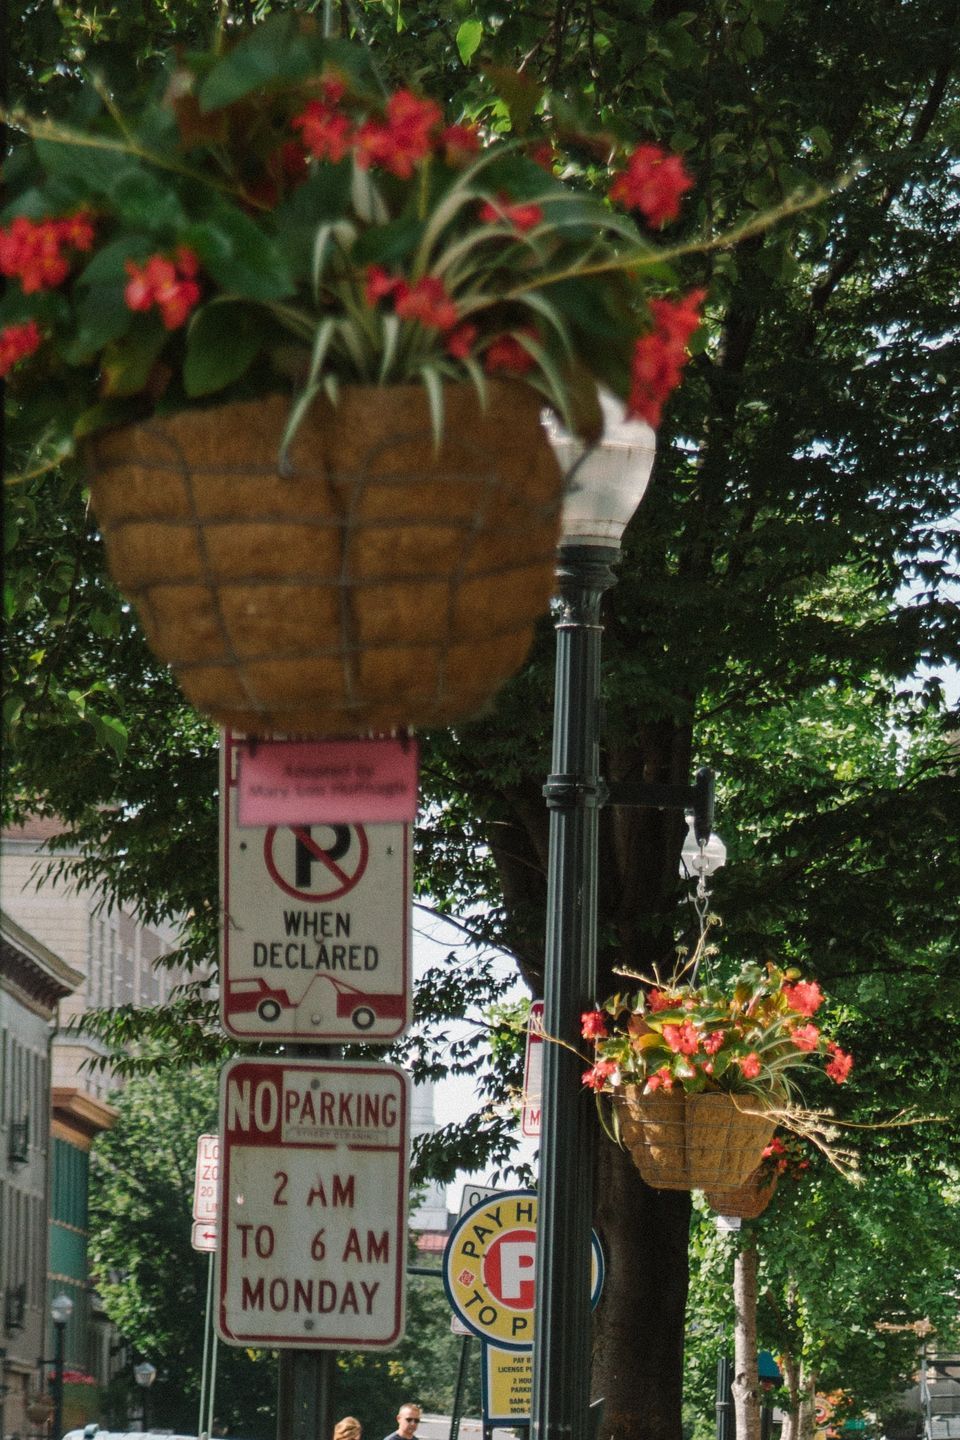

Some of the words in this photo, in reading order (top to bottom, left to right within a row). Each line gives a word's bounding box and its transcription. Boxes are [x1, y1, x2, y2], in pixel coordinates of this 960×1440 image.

[283, 911, 351, 938] WHEN
[253, 943, 379, 971] DECLARED
[227, 1079, 278, 1133] NO
[285, 1090, 397, 1128] PARKING
[272, 1171, 290, 1207] 2
[306, 1172, 356, 1209] AM
[237, 1223, 276, 1259] TO
[310, 1227, 326, 1261] 6
[341, 1228, 390, 1265] AM
[461, 1206, 504, 1259] PAY
[241, 1277, 380, 1317] MONDAY
[464, 1290, 498, 1326] TO
